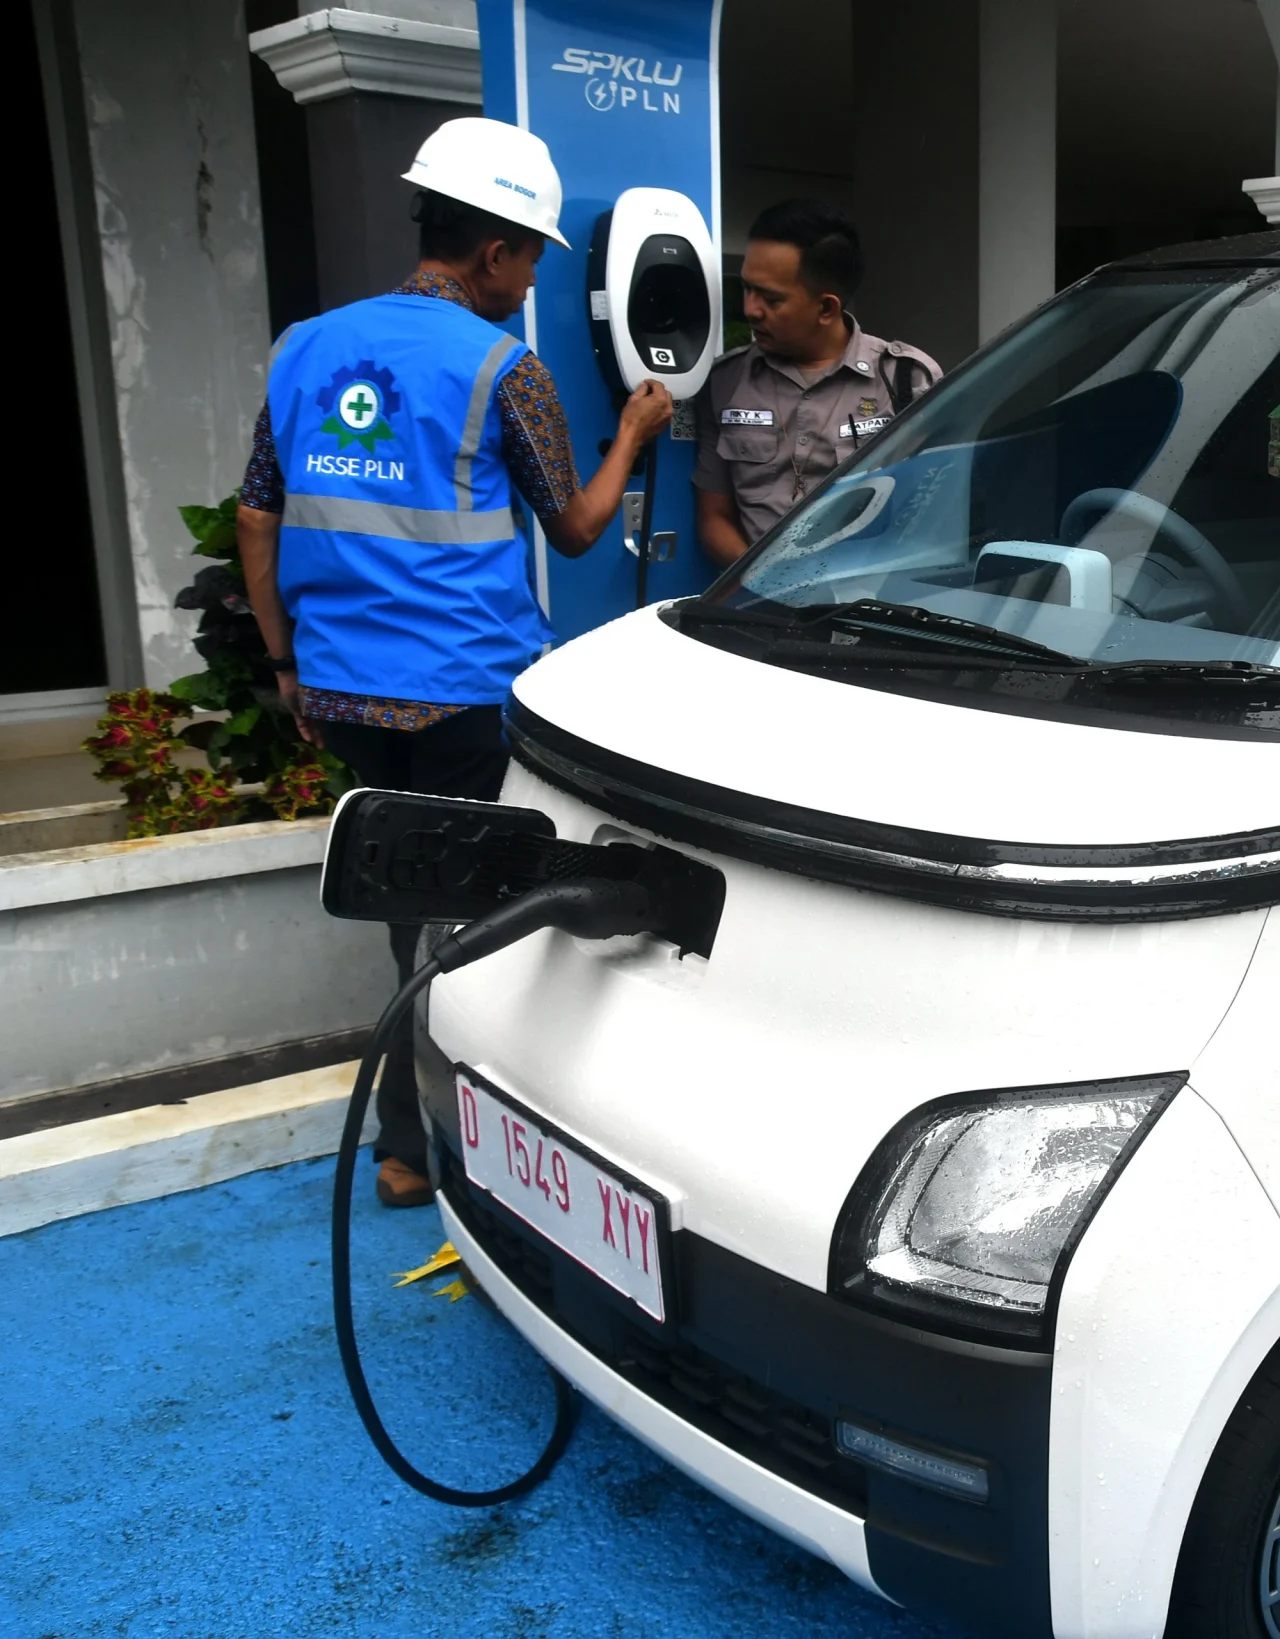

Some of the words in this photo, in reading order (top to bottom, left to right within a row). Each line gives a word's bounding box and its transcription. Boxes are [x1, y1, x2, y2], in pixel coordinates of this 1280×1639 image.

[551, 48, 683, 87] SPKLU
[620, 85, 681, 115] PLN
[306, 454, 360, 476] HSSE
[364, 459, 404, 480] PLN
[462, 1085, 479, 1149] D
[501, 1114, 570, 1213] 1549
[597, 1177, 649, 1274] XYY
